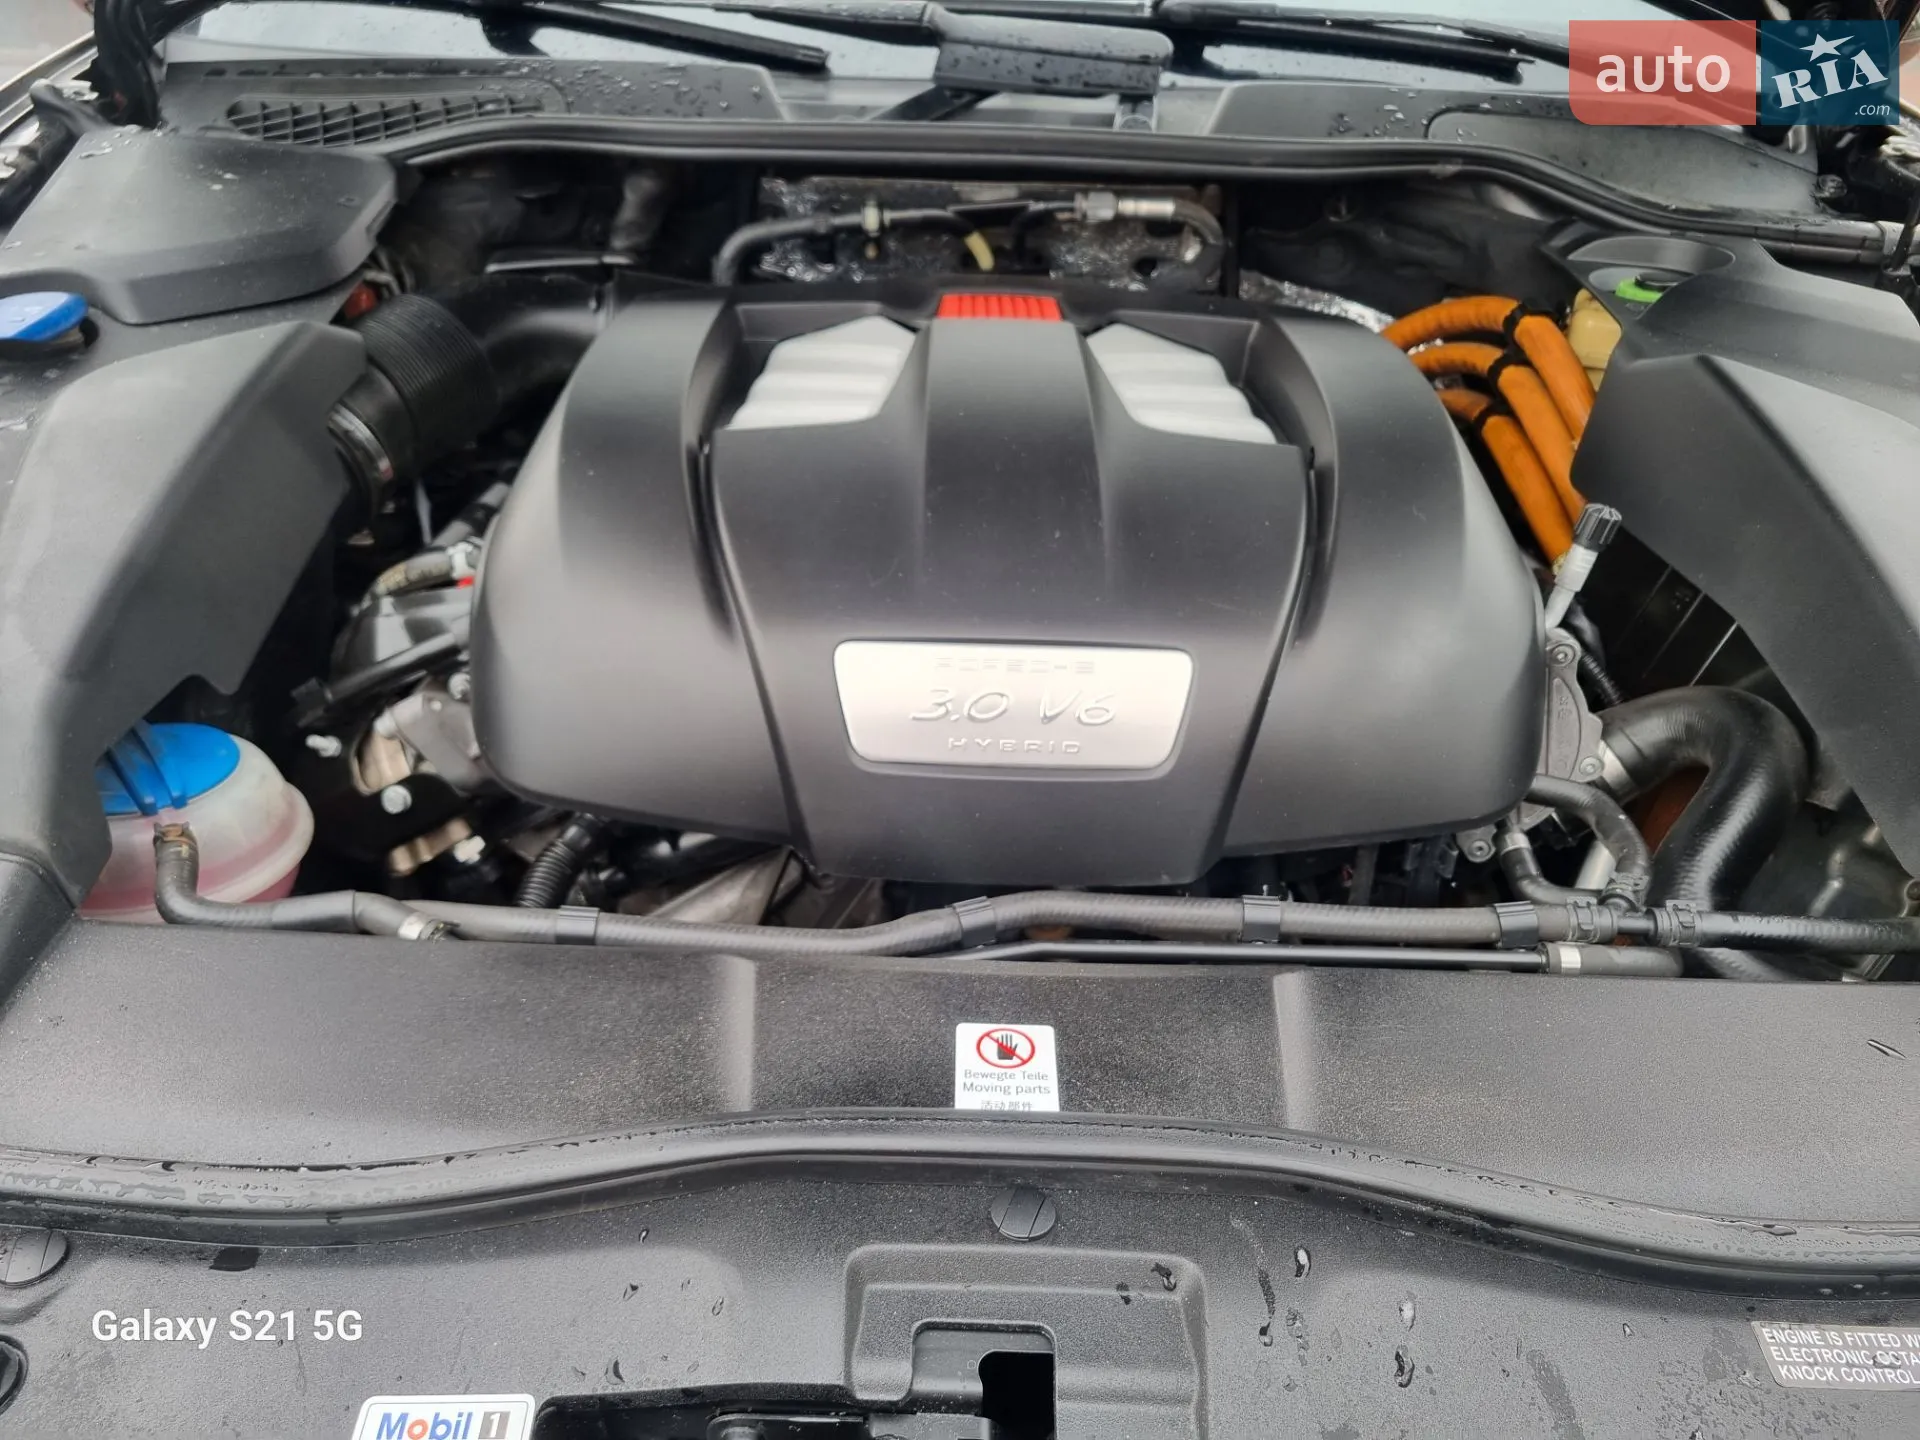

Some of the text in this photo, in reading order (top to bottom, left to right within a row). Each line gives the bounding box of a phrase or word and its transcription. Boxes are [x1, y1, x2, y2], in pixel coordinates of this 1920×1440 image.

[909, 689, 1117, 726] 3.0 V6
[947, 737, 1081, 754] HYBRID
[964, 1069, 1048, 1081] Bewegte Teile
[963, 1082, 1051, 1095] Moving parts
[1762, 1328, 1825, 1345] ENGINE
[1825, 1331, 1843, 1345] IS
[1844, 1332, 1901, 1347] FITTED
[1770, 1346, 1920, 1366] ELECTRONIC OCTA
[1777, 1365, 1920, 1384] KNOCK CONTROL
[377, 1412, 473, 1440] Mobil
